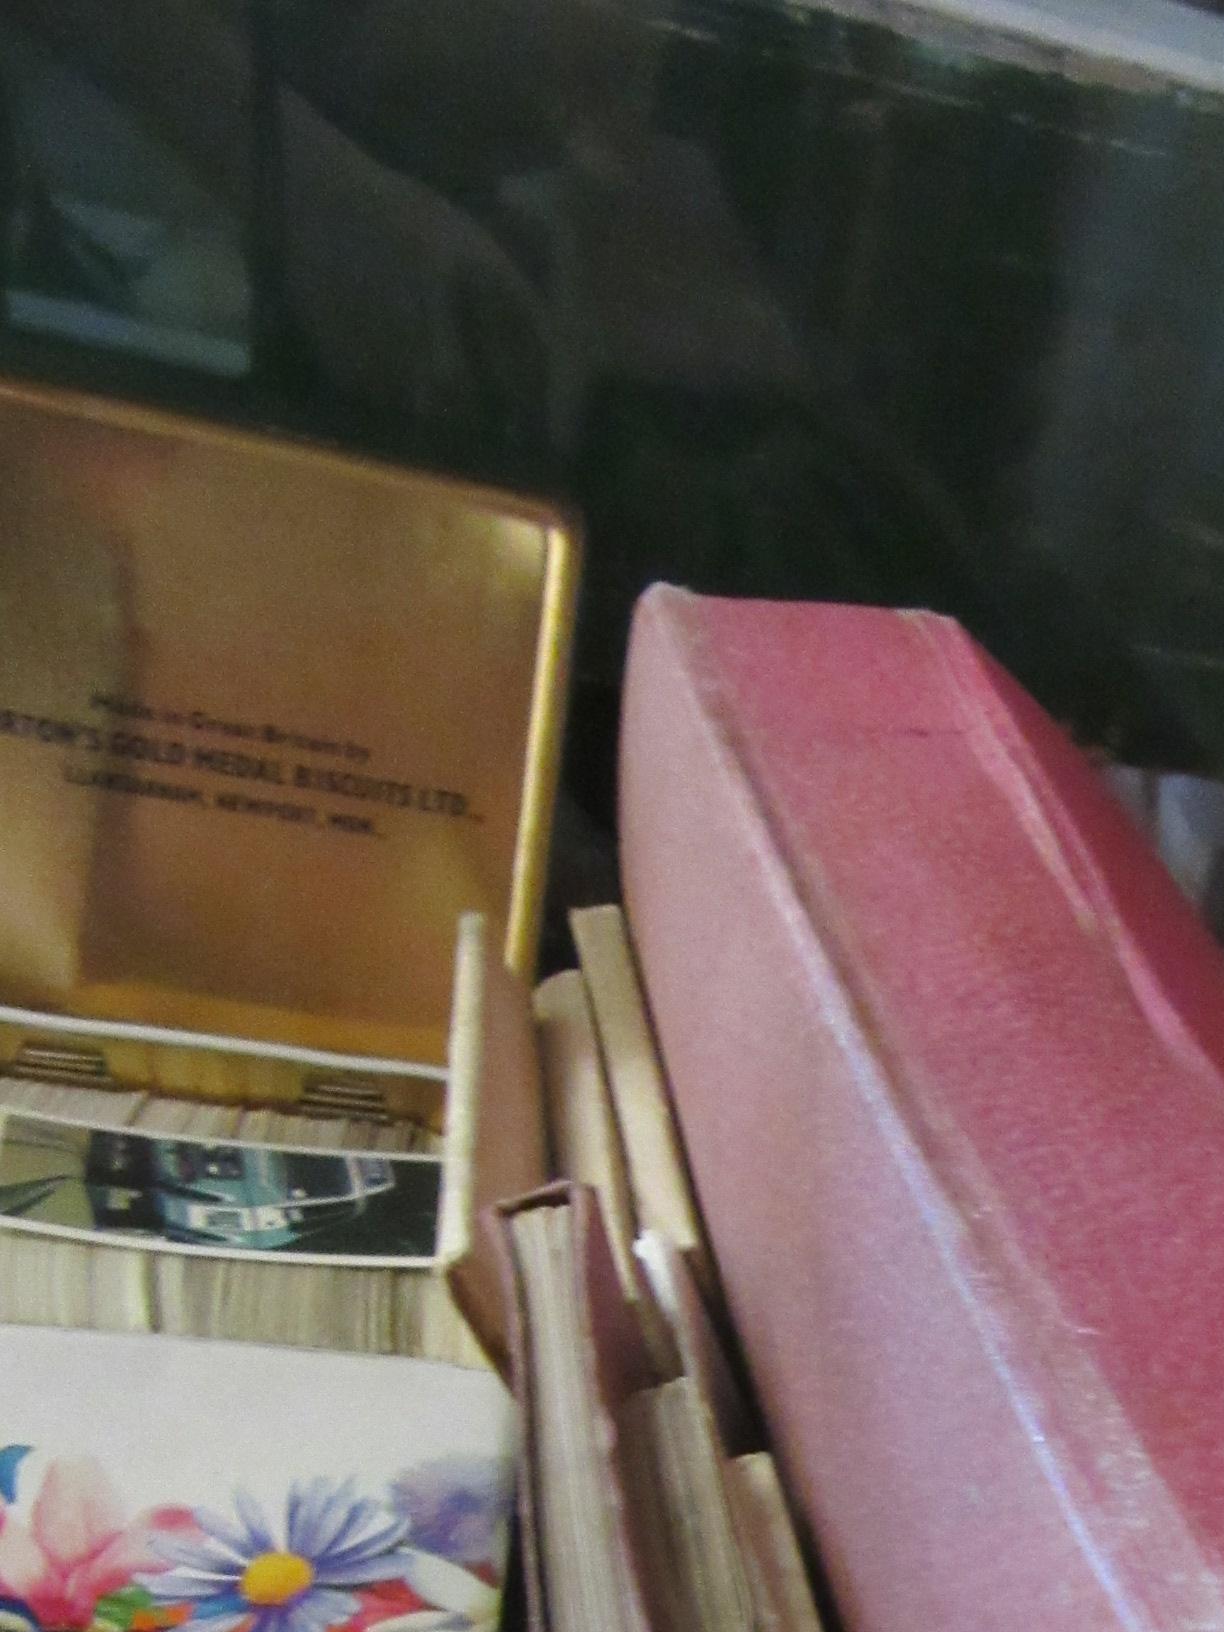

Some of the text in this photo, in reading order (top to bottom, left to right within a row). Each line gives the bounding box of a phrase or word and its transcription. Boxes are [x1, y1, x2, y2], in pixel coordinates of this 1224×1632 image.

[109, 730, 190, 767] GOLD
[194, 750, 285, 787] MEDAL
[294, 763, 412, 809] BISCUITS
